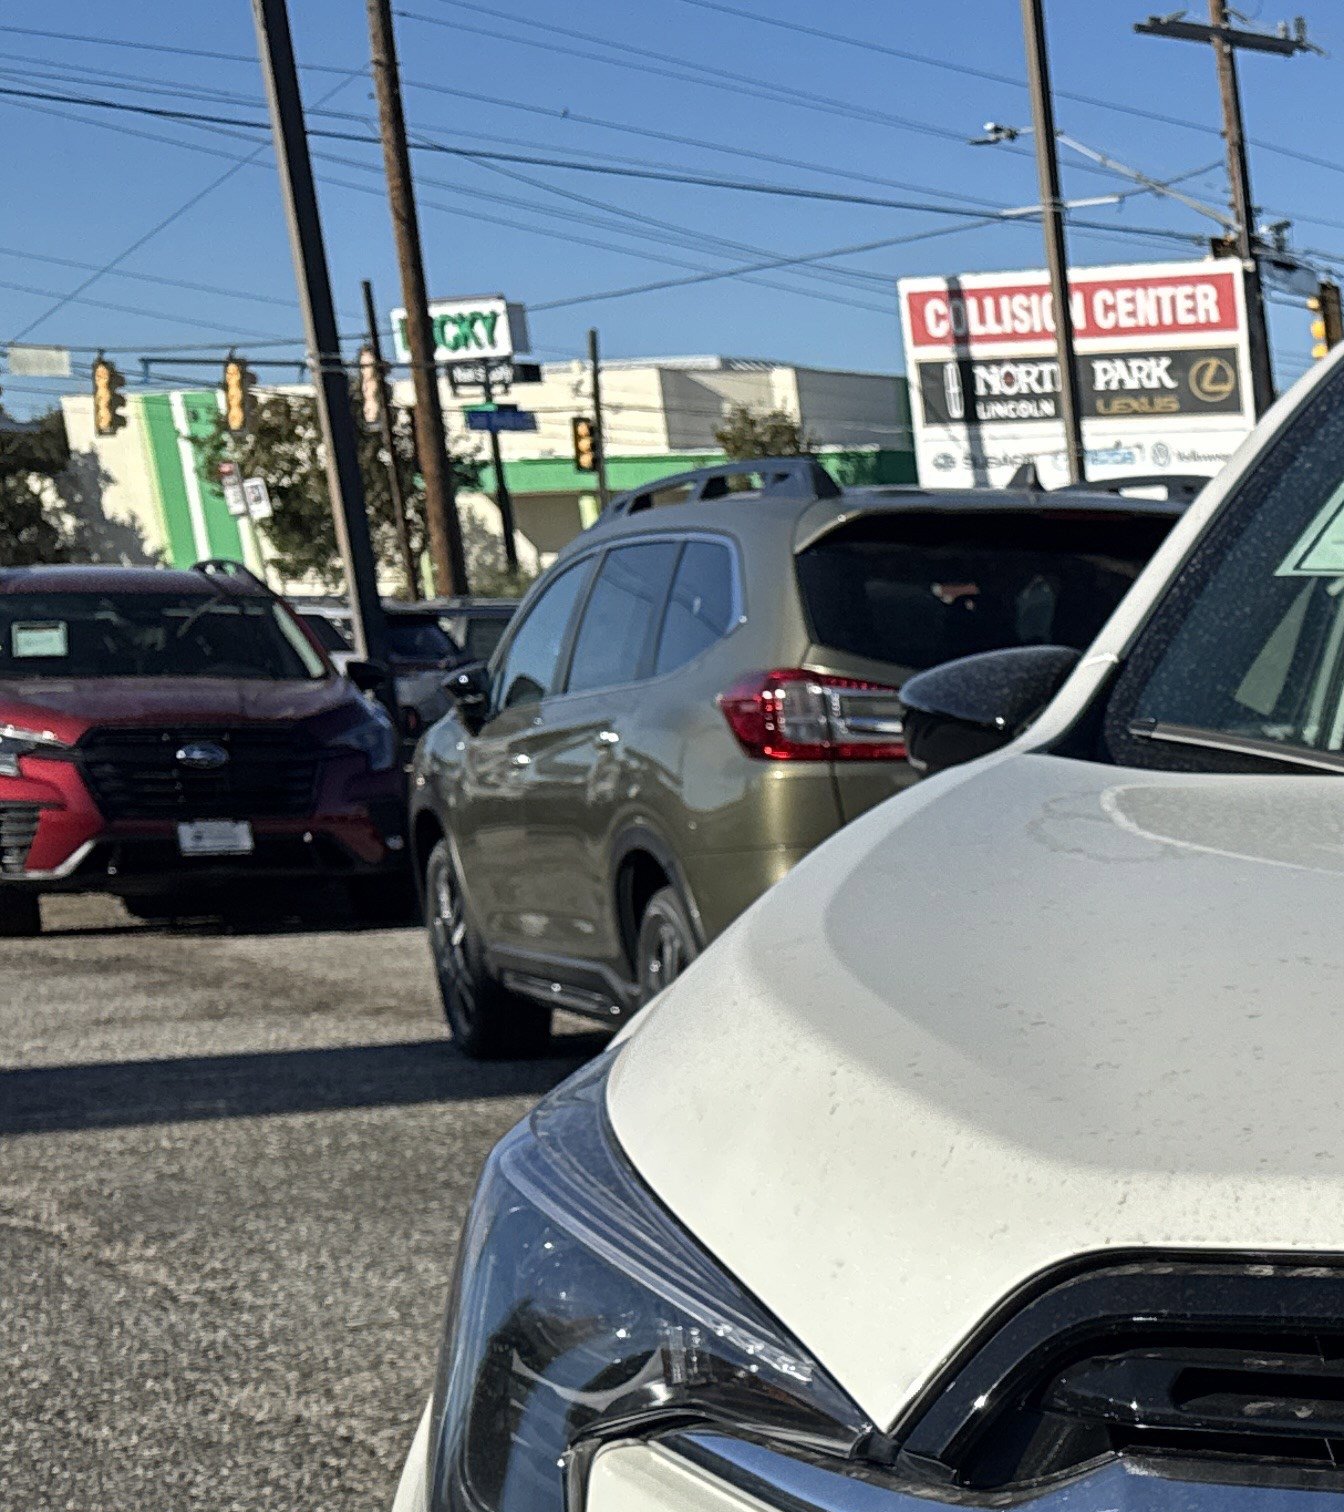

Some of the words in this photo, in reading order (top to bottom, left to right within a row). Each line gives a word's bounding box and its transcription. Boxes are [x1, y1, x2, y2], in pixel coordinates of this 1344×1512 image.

[1092, 283, 1221, 329] CENTER
[399, 311, 499, 352] CKY
[1091, 356, 1179, 391] PARK
[975, 398, 1056, 420] LINCOLN
[1096, 394, 1180, 415] LEXUS
